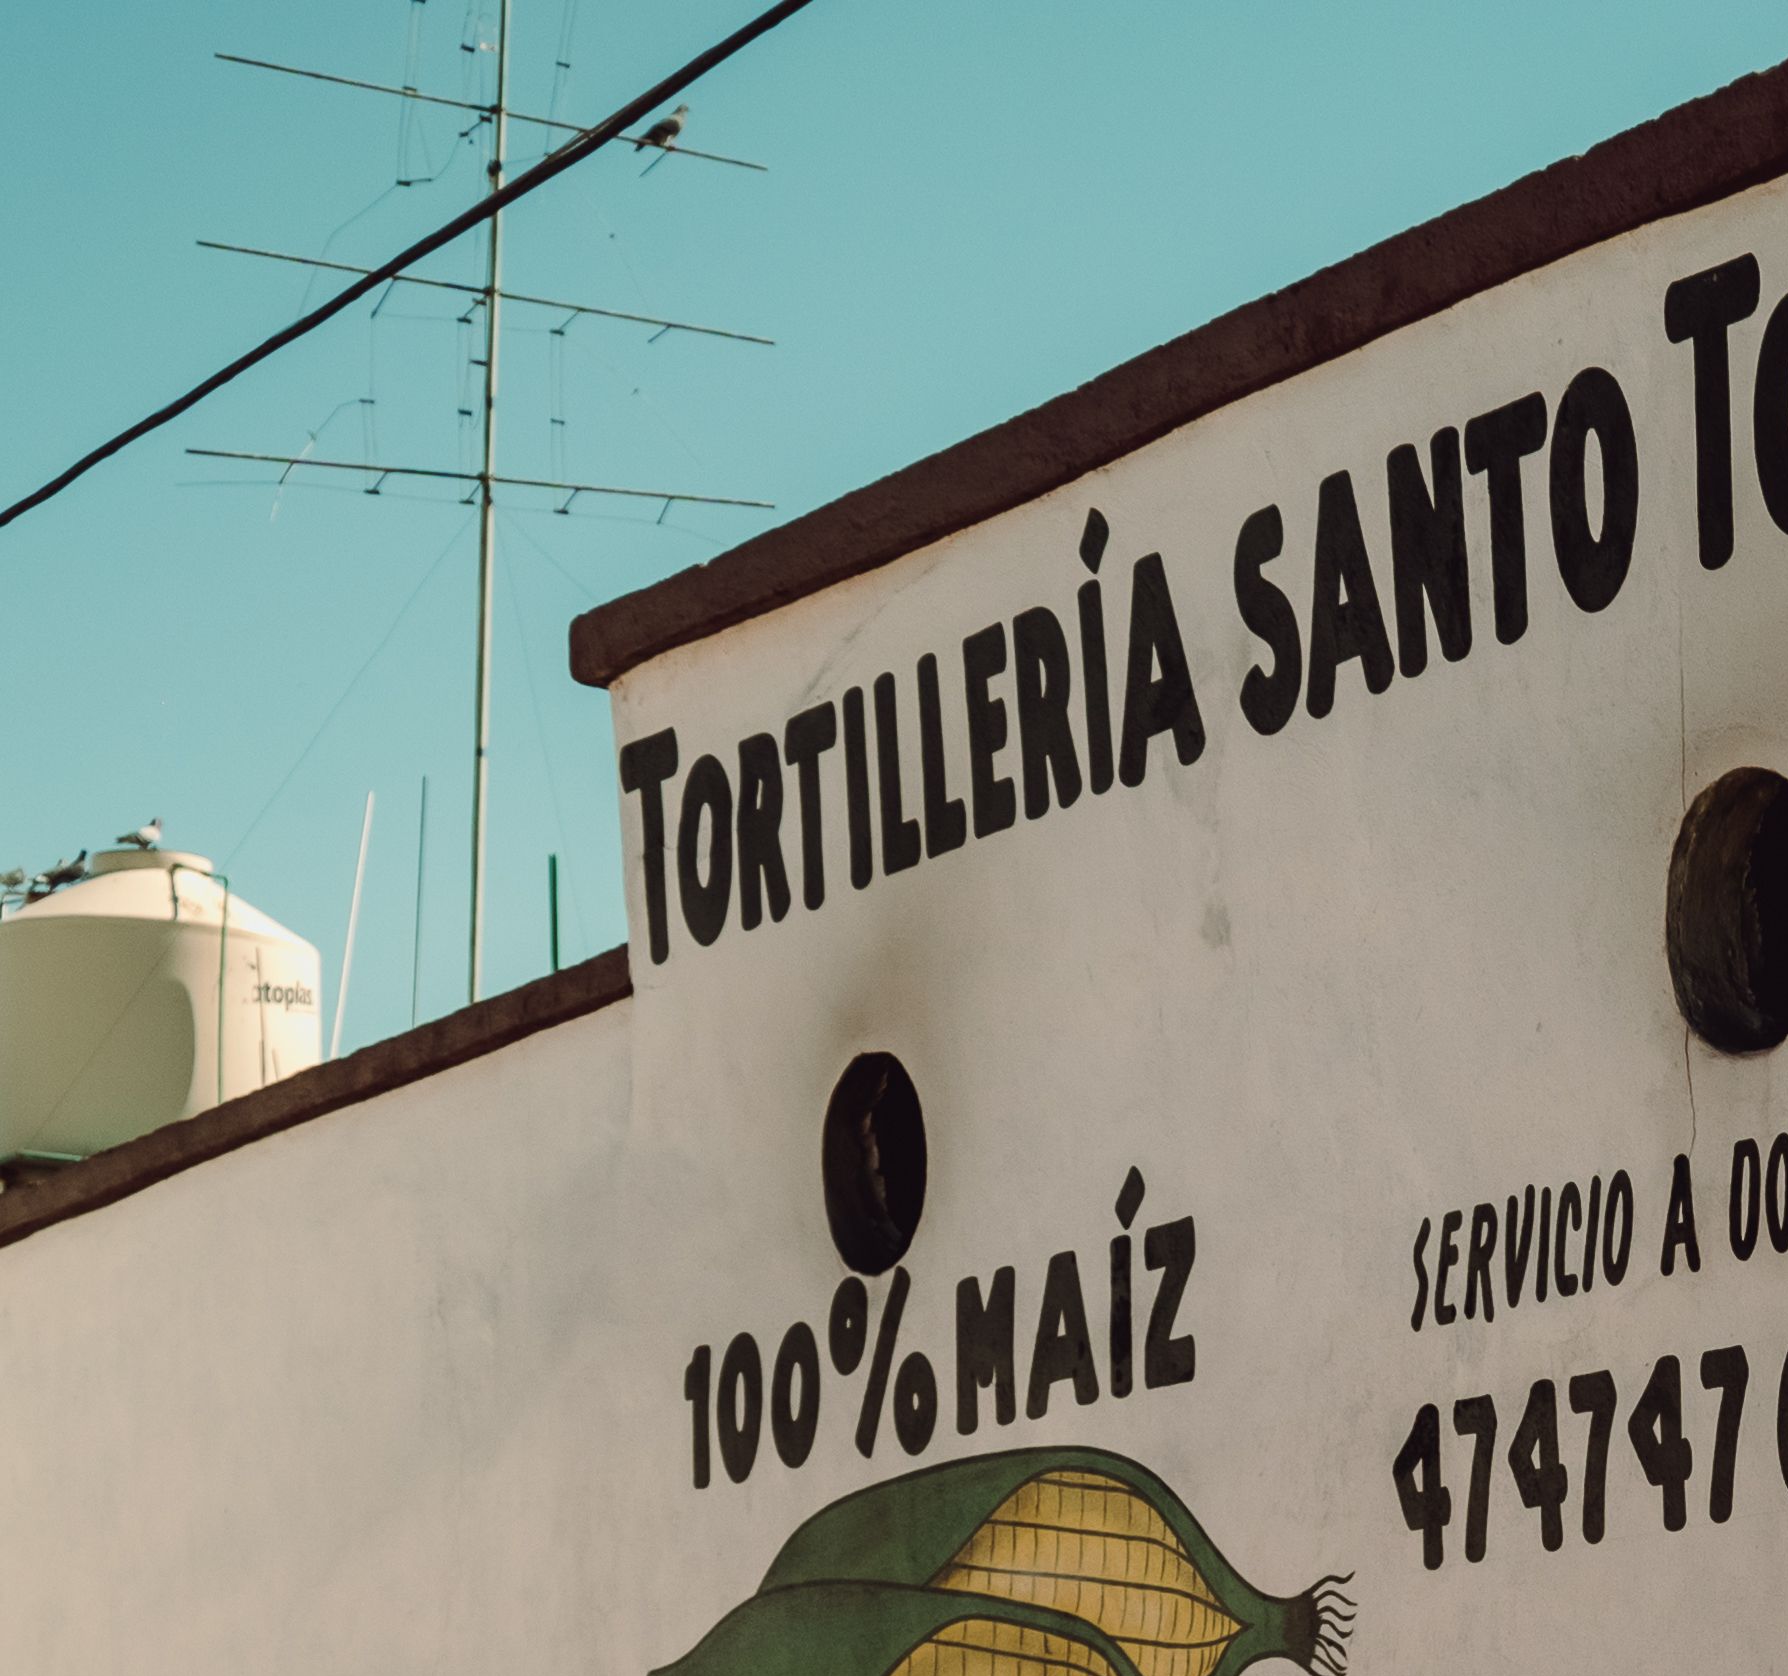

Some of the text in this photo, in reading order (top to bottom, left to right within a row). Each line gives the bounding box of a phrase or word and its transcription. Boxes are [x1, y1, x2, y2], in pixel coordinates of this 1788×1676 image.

[620, 508, 1207, 966] TORTILLERÍA
[1234, 367, 1639, 735] SANTO
[684, 1165, 1196, 1490] 100% MAÍZ
[1410, 1168, 1635, 1332] SERVICIO
[1660, 1154, 1701, 1276] A
